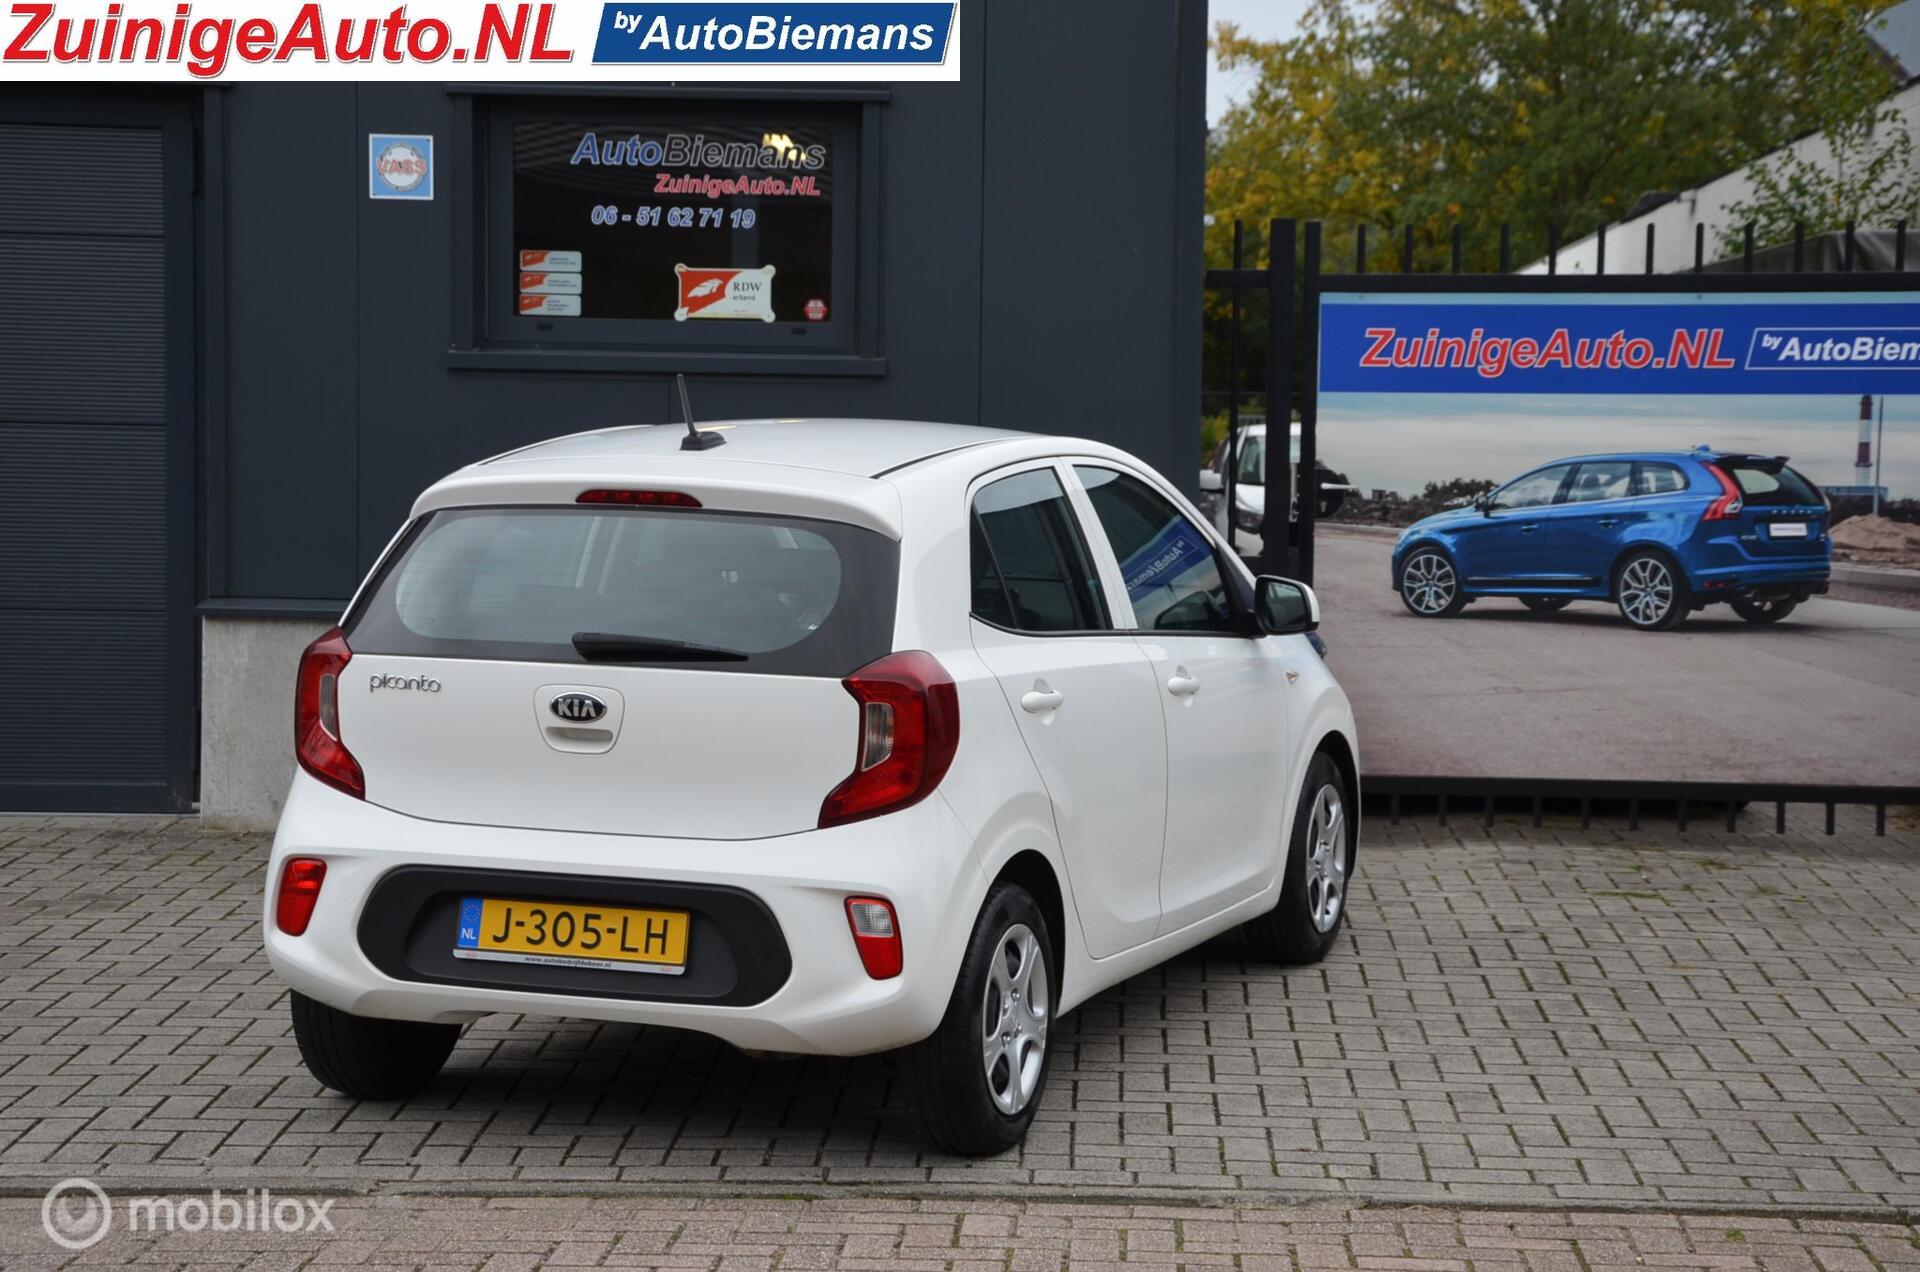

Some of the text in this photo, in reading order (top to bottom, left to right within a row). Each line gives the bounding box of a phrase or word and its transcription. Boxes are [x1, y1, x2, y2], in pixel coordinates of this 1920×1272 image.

[570, 132, 827, 170] AutoBiemans
[654, 173, 822, 198] ZuinigeAuto.NL
[591, 205, 618, 226] 06
[635, 206, 662, 227] 51
[667, 207, 694, 228] 62
[699, 207, 724, 228] 71
[730, 208, 756, 229] 19
[732, 281, 762, 292] RDW
[1359, 327, 1735, 378] ZuinigeAuto.NL
[1761, 333, 1783, 350] by
[369, 672, 442, 694] picanto
[557, 697, 598, 719] KIA
[461, 927, 477, 940] NL
[492, 907, 669, 956] J-305-LH
